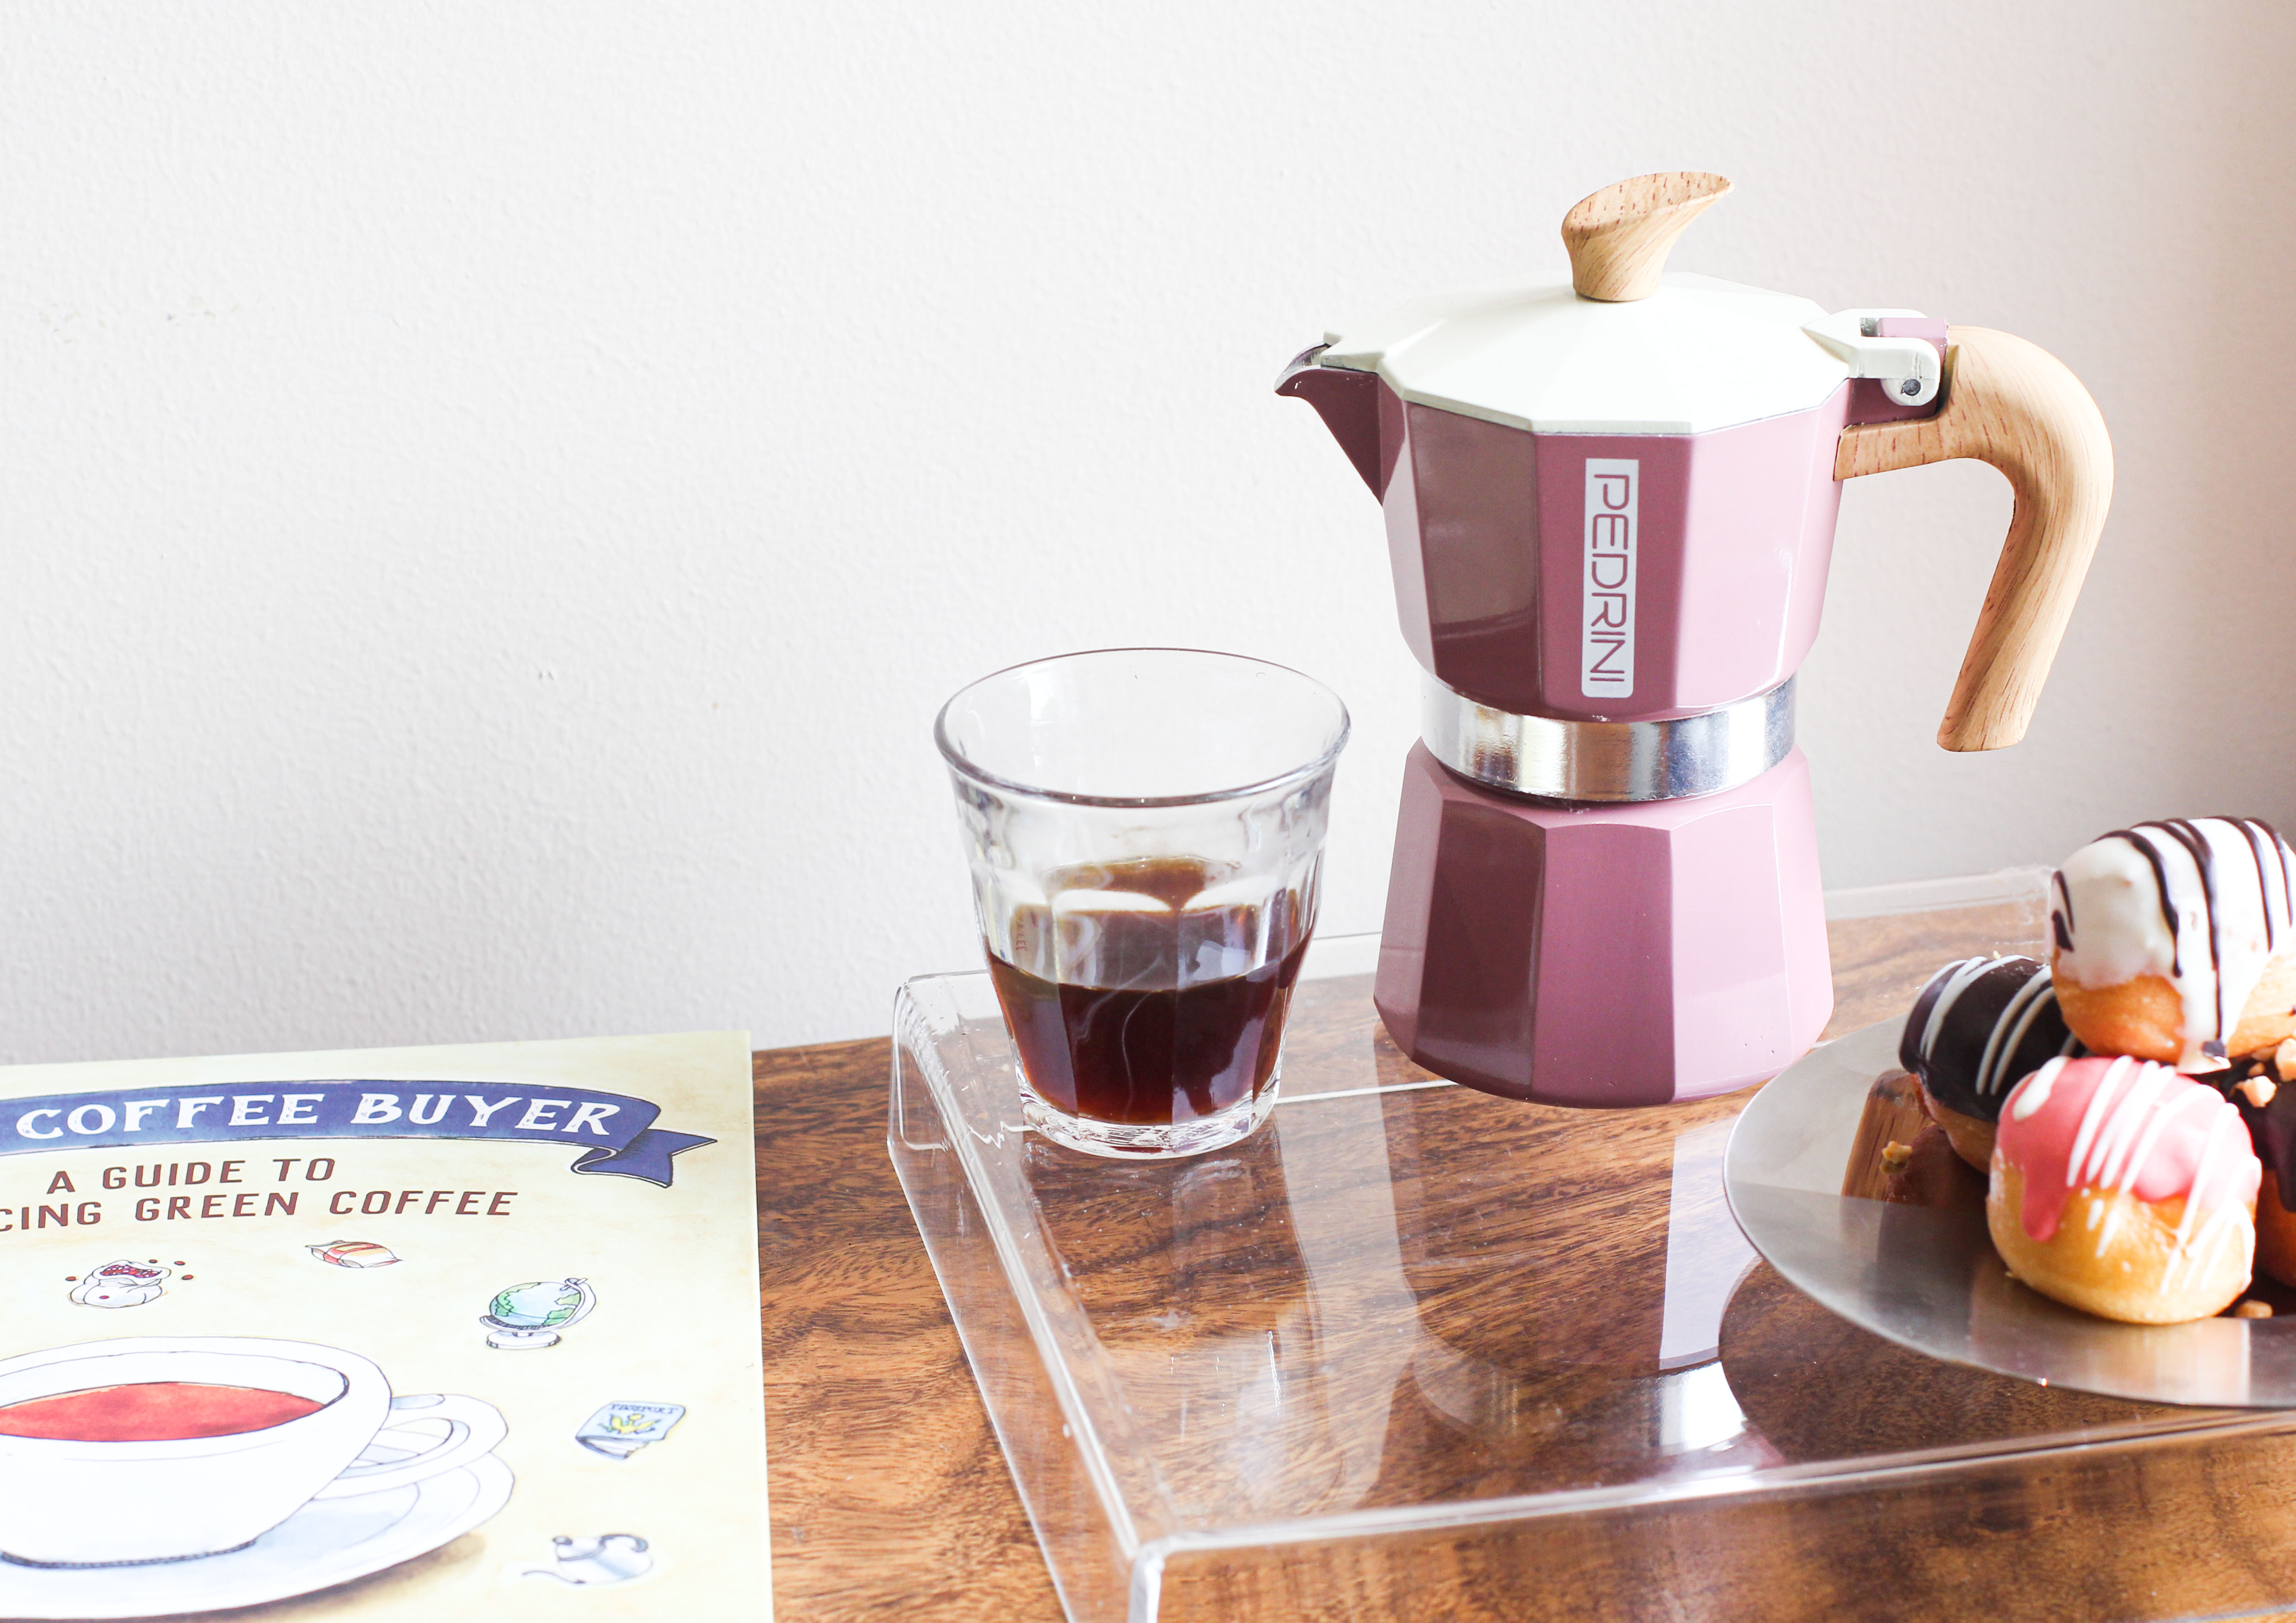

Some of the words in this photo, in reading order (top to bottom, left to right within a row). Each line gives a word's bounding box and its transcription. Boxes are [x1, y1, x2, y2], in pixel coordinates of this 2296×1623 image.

[1590, 474, 1630, 682] PEDRINI
[16, 1093, 325, 1139] COFFEE
[350, 1093, 621, 1135] BUYER
[47, 1170, 76, 1194] A
[102, 1160, 246, 1189] GUIDE
[272, 1158, 335, 1181] TO
[135, 1192, 299, 1221] GREEN
[329, 1191, 518, 1215] COFFEE
